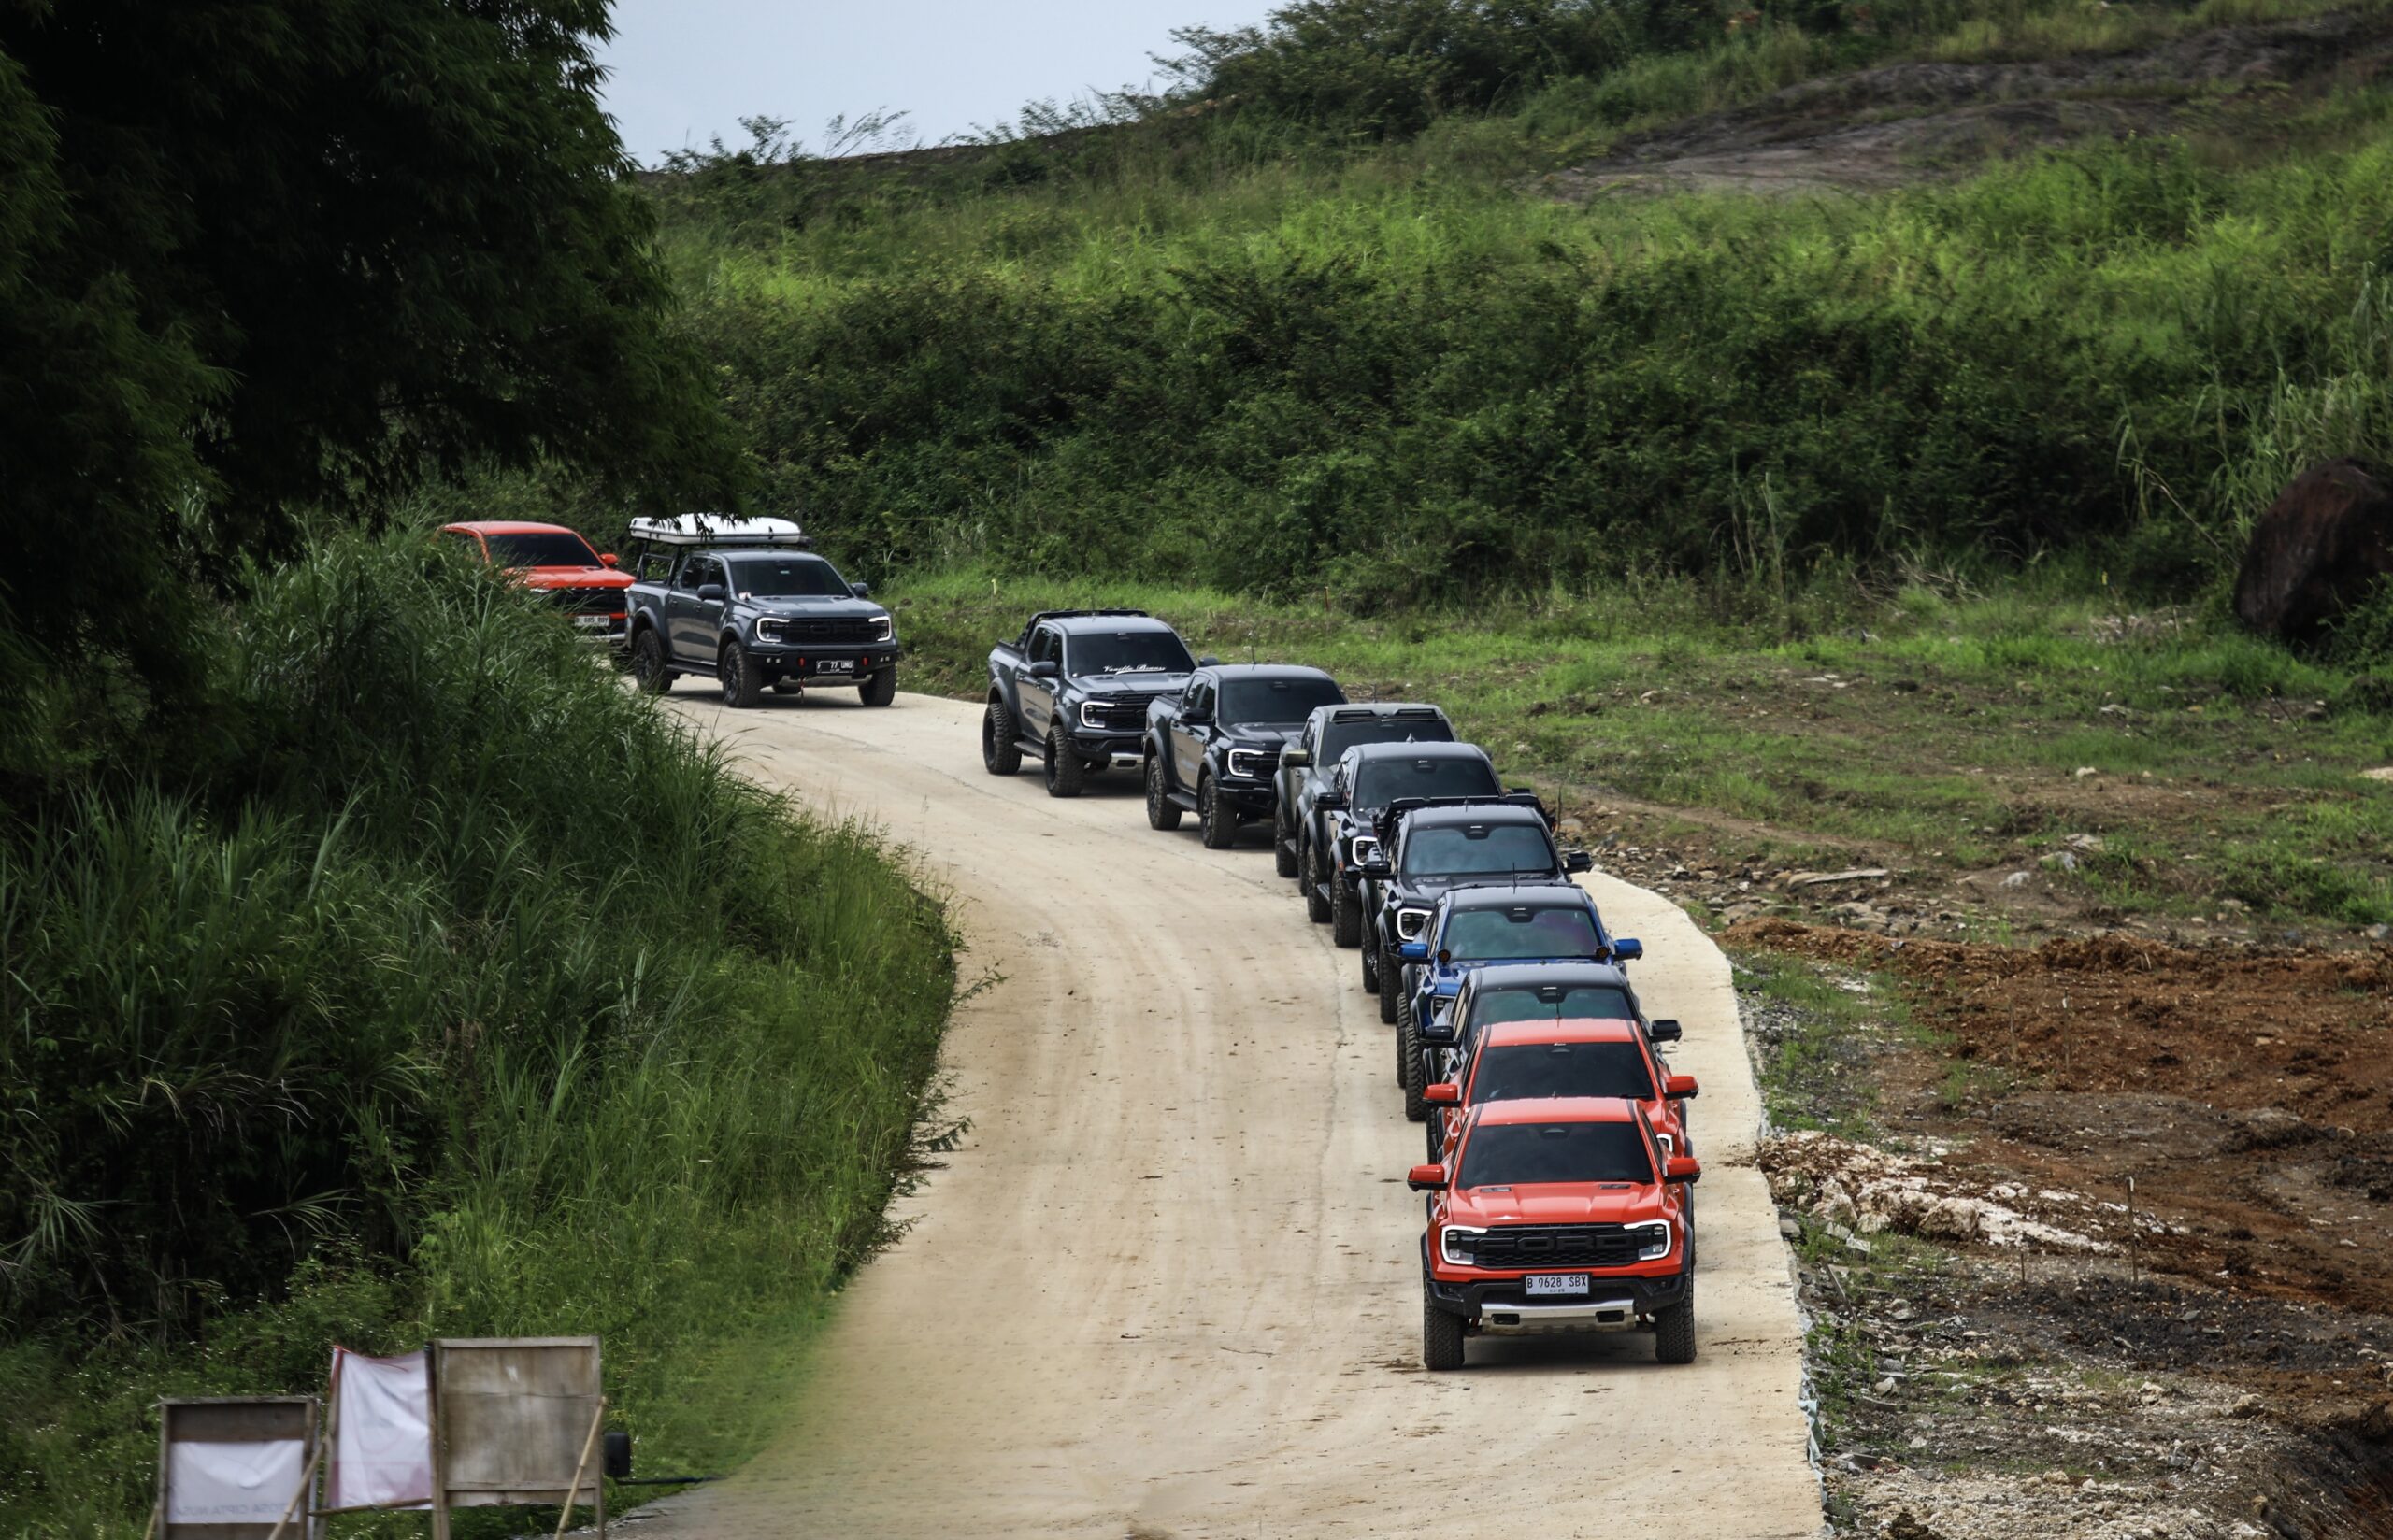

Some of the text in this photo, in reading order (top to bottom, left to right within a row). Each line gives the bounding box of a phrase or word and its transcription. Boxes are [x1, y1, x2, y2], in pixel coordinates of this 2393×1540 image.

[1477, 1234, 1636, 1253] FORD
[1527, 1276, 1587, 1289] B 9628 SBX
